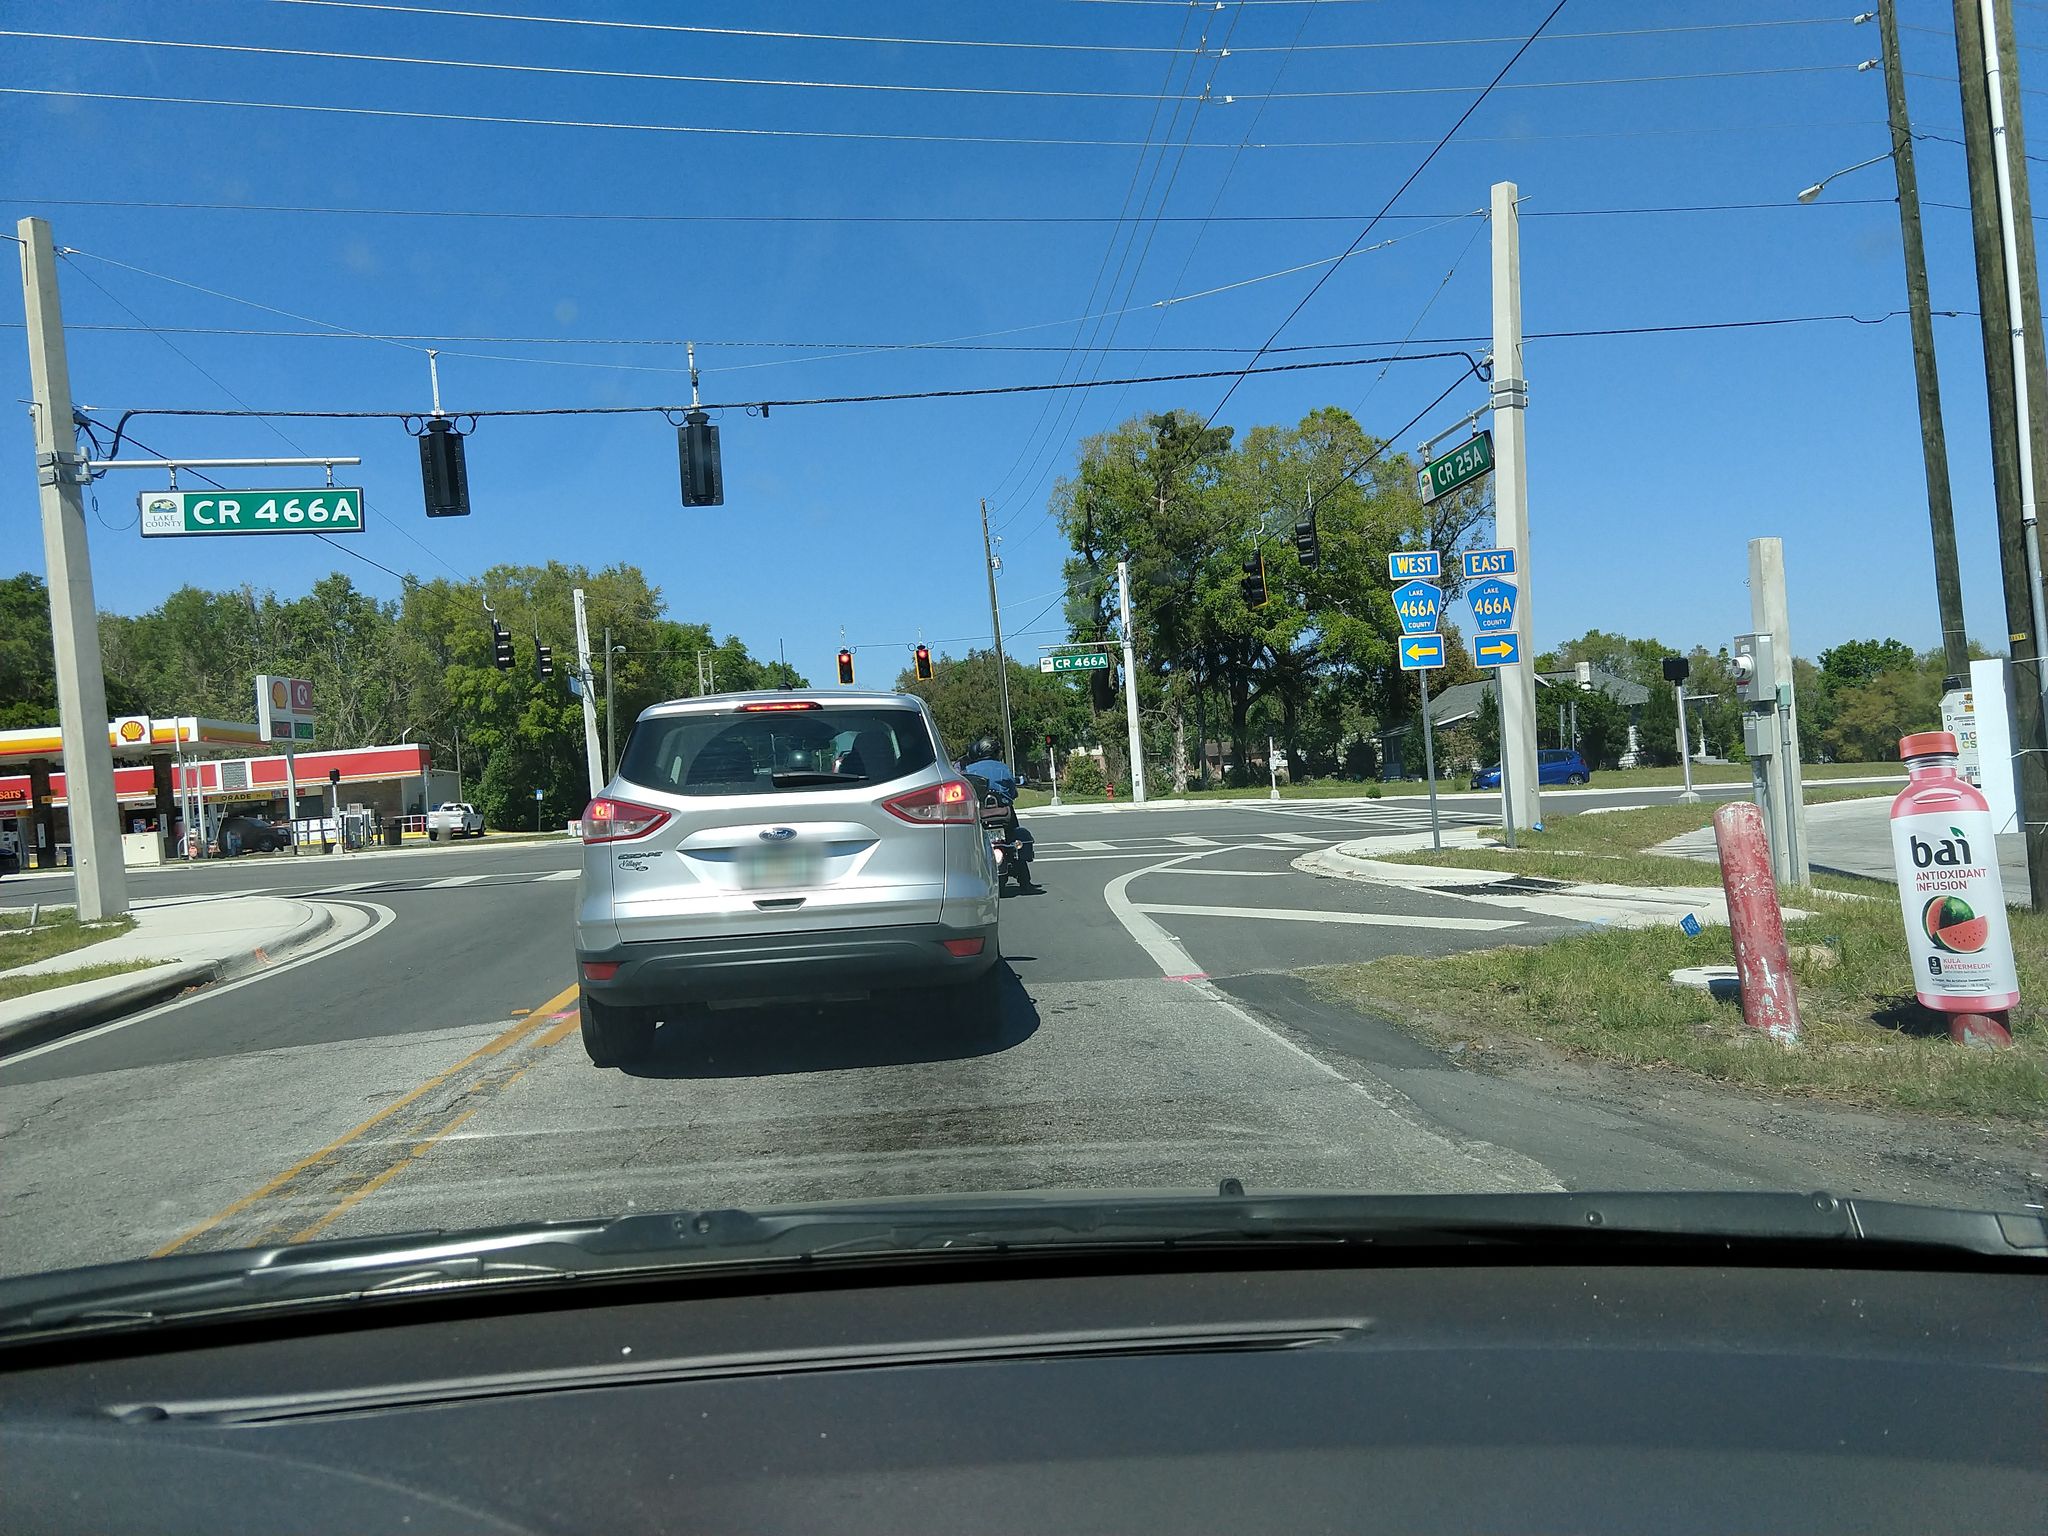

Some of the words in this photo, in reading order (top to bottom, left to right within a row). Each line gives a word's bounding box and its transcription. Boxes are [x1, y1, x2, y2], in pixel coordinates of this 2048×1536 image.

[1437, 464, 1455, 486] CR
[1455, 446, 1484, 477] 25A
[153, 514, 176, 522] LAKE
[192, 500, 241, 525] CR
[254, 498, 357, 523] 466A
[145, 520, 182, 528] COUNTY
[1396, 556, 1432, 575] WEST
[1471, 555, 1507, 573] EAST
[1483, 587, 1499, 595] LAKE
[1400, 599, 1436, 617] 466A
[1474, 597, 1512, 616] 466A
[1408, 621, 1431, 629] COUNTY
[1482, 619, 1507, 627] COUNTY
[1055, 658, 1071, 668] CR
[1074, 656, 1106, 667] 466A
[1909, 828, 1973, 869] bai
[1915, 868, 1988, 882] ANTIOXIDANT
[1916, 880, 1968, 892] INFUSION
[1931, 958, 1937, 967] 5
